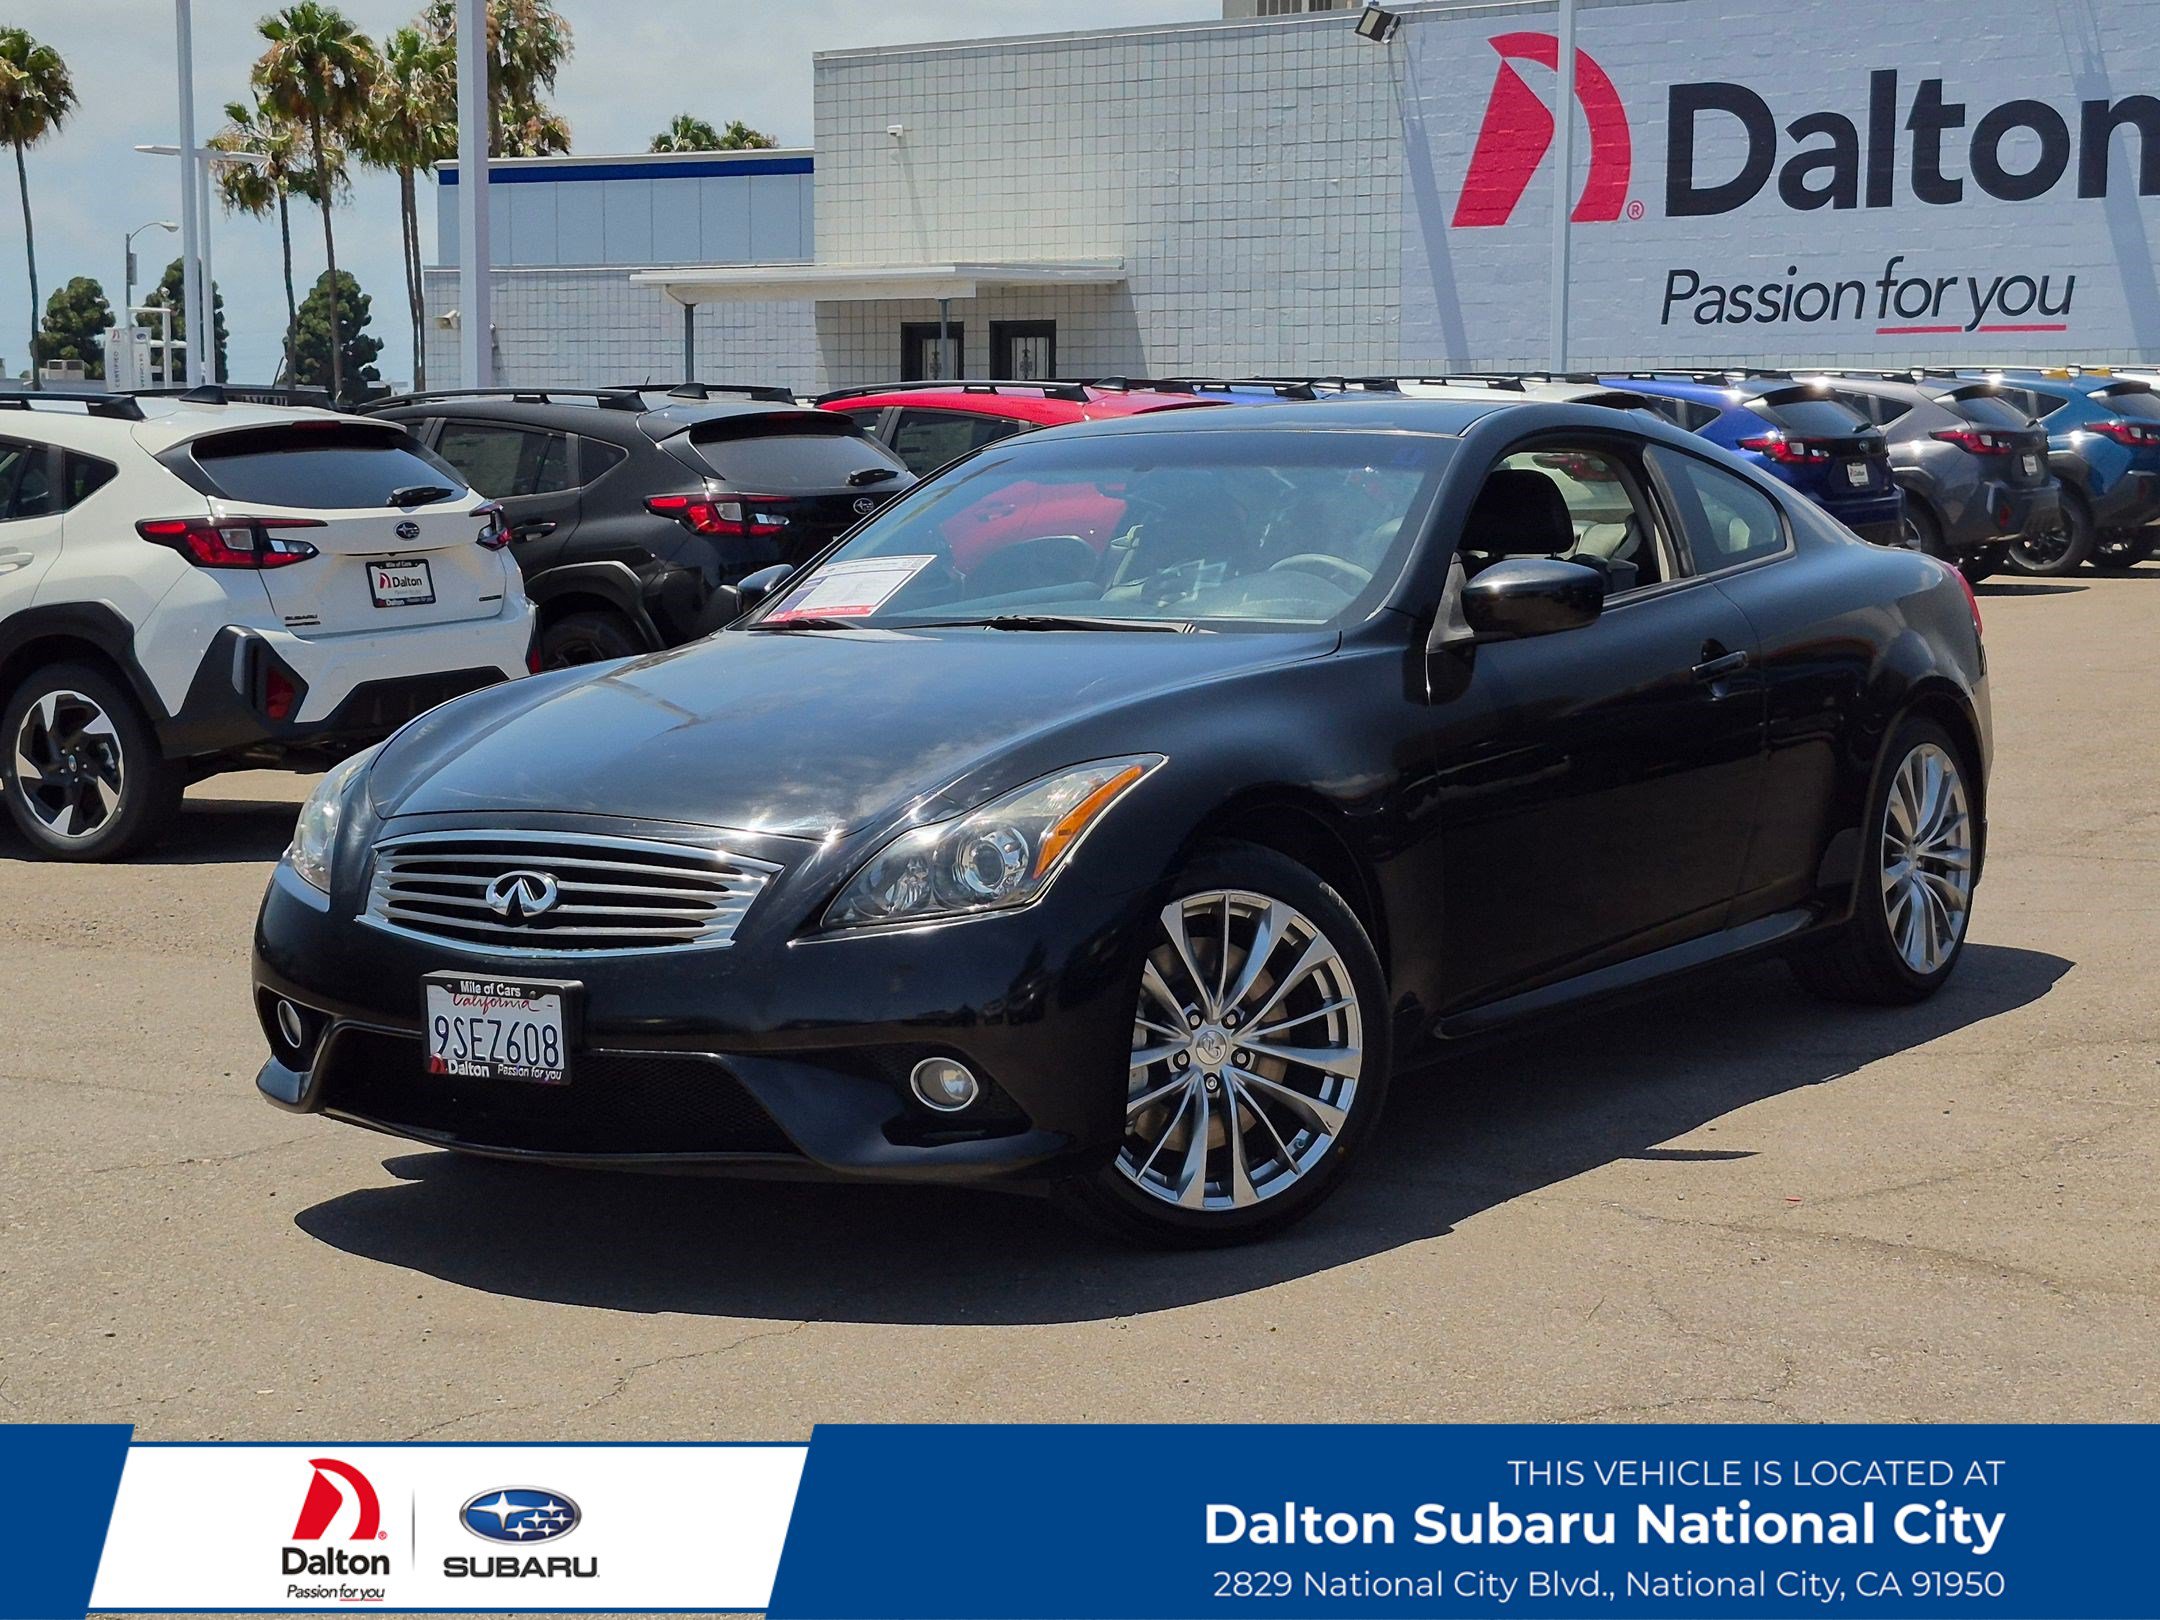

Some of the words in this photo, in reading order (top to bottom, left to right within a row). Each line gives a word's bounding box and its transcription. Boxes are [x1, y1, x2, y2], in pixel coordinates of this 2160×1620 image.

[1665, 69, 2160, 217] Dalton
[1661, 266, 1866, 326] Passion
[1876, 256, 1958, 320] for
[1963, 274, 2076, 333] you
[392, 575, 423, 588] Dalton
[460, 980, 481, 994] Mile
[483, 983, 495, 995] of
[496, 983, 521, 998] Cars
[453, 993, 541, 1015] California
[434, 1015, 559, 1068] 9SEZ608
[447, 1060, 490, 1077] Dalton
[497, 1063, 529, 1077] Passion
[531, 1066, 544, 1079] for
[544, 1070, 562, 1081] you
